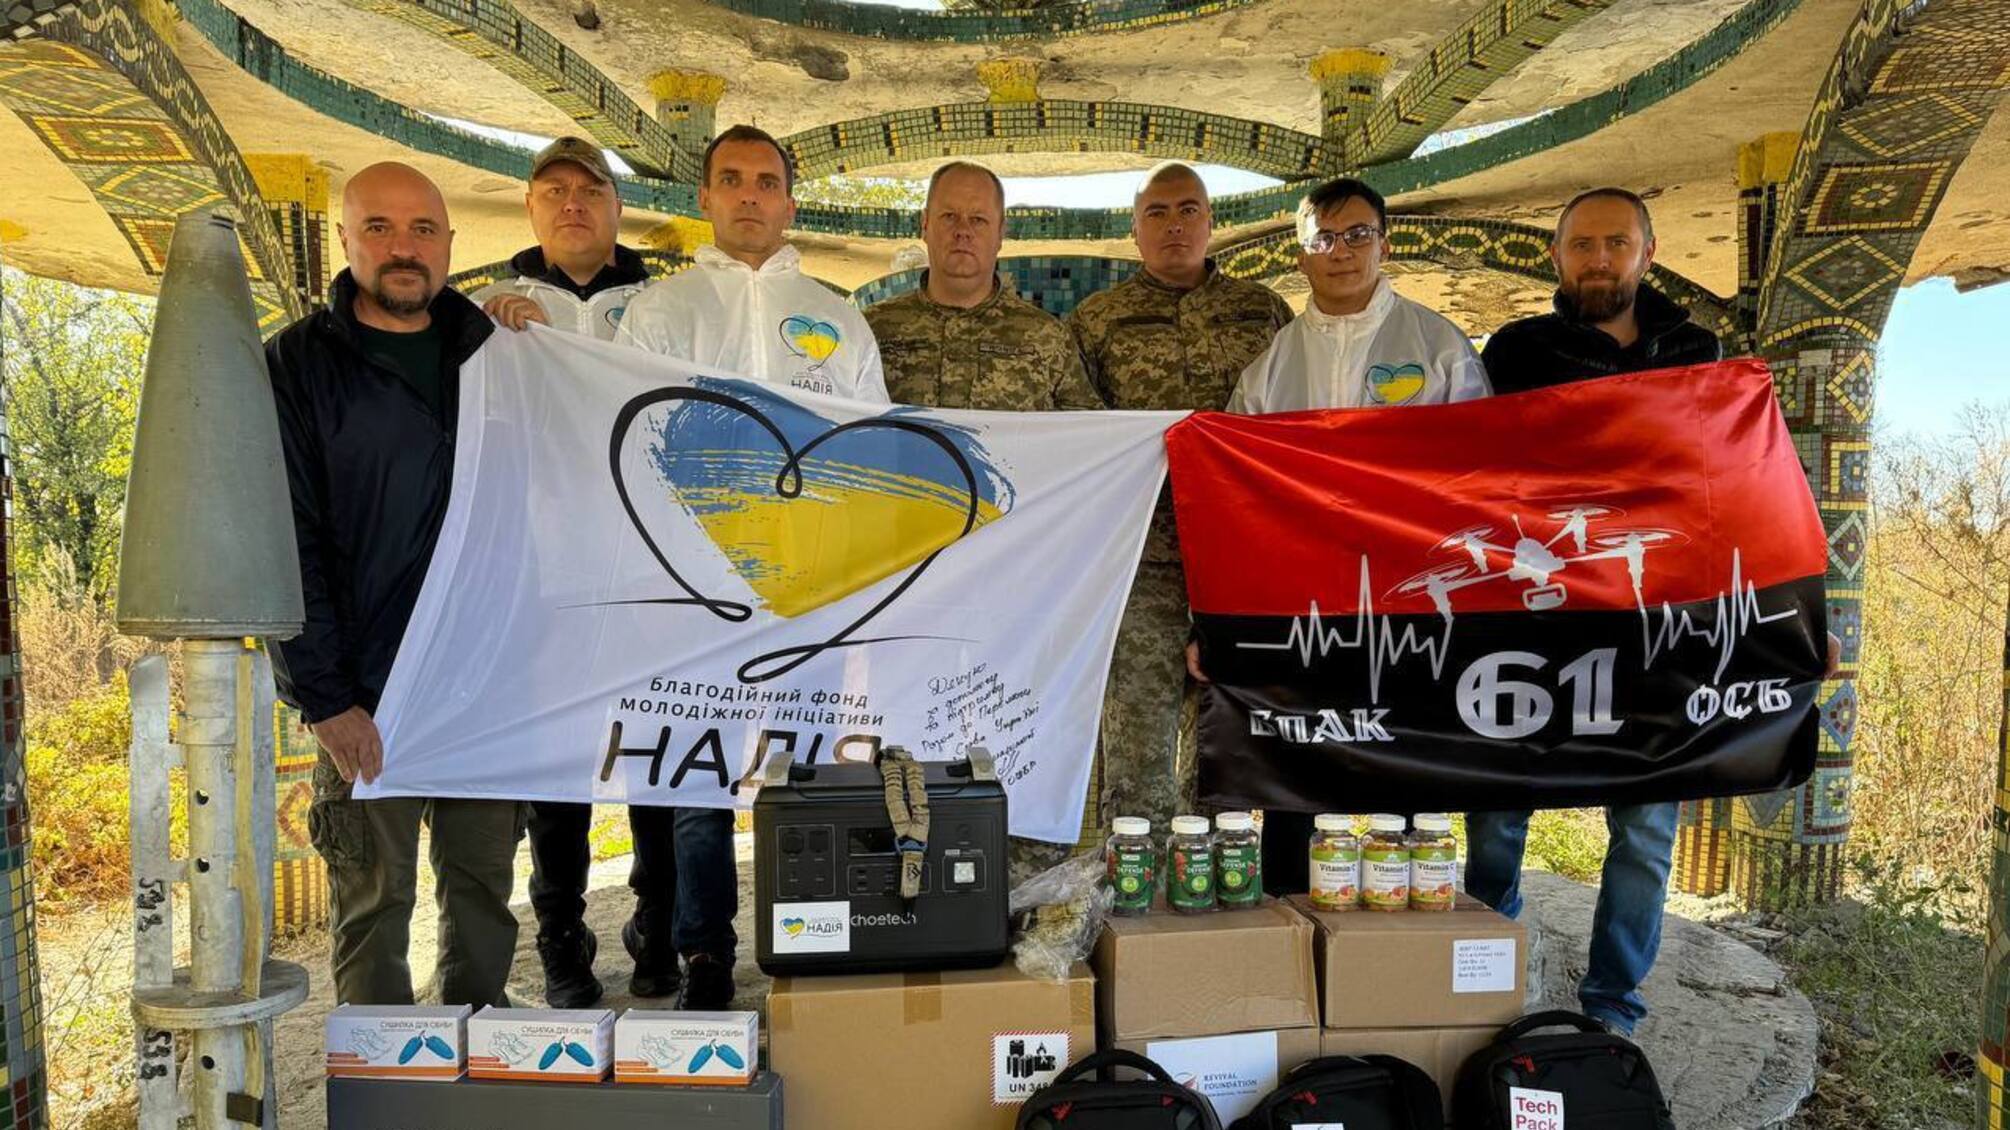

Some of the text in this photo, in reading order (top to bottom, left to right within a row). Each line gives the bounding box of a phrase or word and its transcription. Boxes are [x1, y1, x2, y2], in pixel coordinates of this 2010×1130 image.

[791, 380, 833, 395] НАДІЯ
[650, 676, 868, 709] Благодійний фонд
[1456, 647, 1625, 740] 61
[1686, 677, 1793, 726] ОСБ
[619, 697, 885, 726] молодіжної ініціативи
[1320, 863, 1351, 872] Vitamin
[1373, 863, 1403, 872] Vitamin
[1418, 862, 1449, 871] Vitamin
[806, 922, 843, 933] НАДІЯ
[1204, 1072, 1238, 1081] REVIVAL
[1009, 1082, 1026, 1093] UN
[1204, 1080, 1257, 1090] FOUNDATION
[1515, 1096, 1558, 1115] Tech
[1515, 1114, 1558, 1130] Pack
